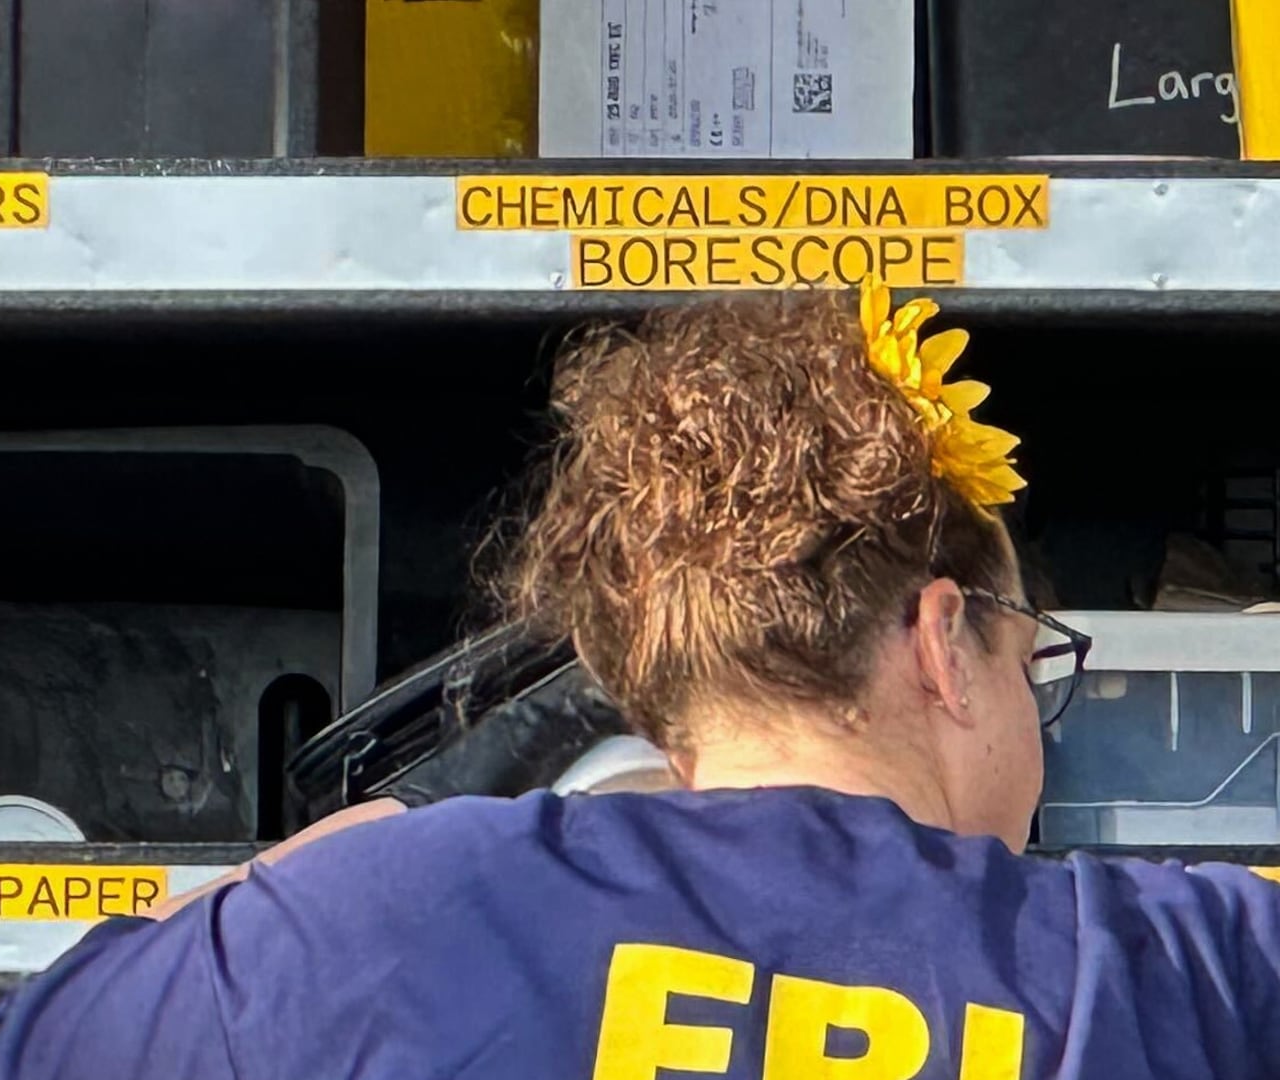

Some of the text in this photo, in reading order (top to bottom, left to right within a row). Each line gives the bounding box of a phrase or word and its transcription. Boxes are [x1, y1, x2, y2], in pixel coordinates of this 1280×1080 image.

[1108, 42, 1239, 123] Larg
[461, 180, 1045, 229] CHEMICALS/DNA BOX
[579, 236, 958, 288] BORESCOPE
